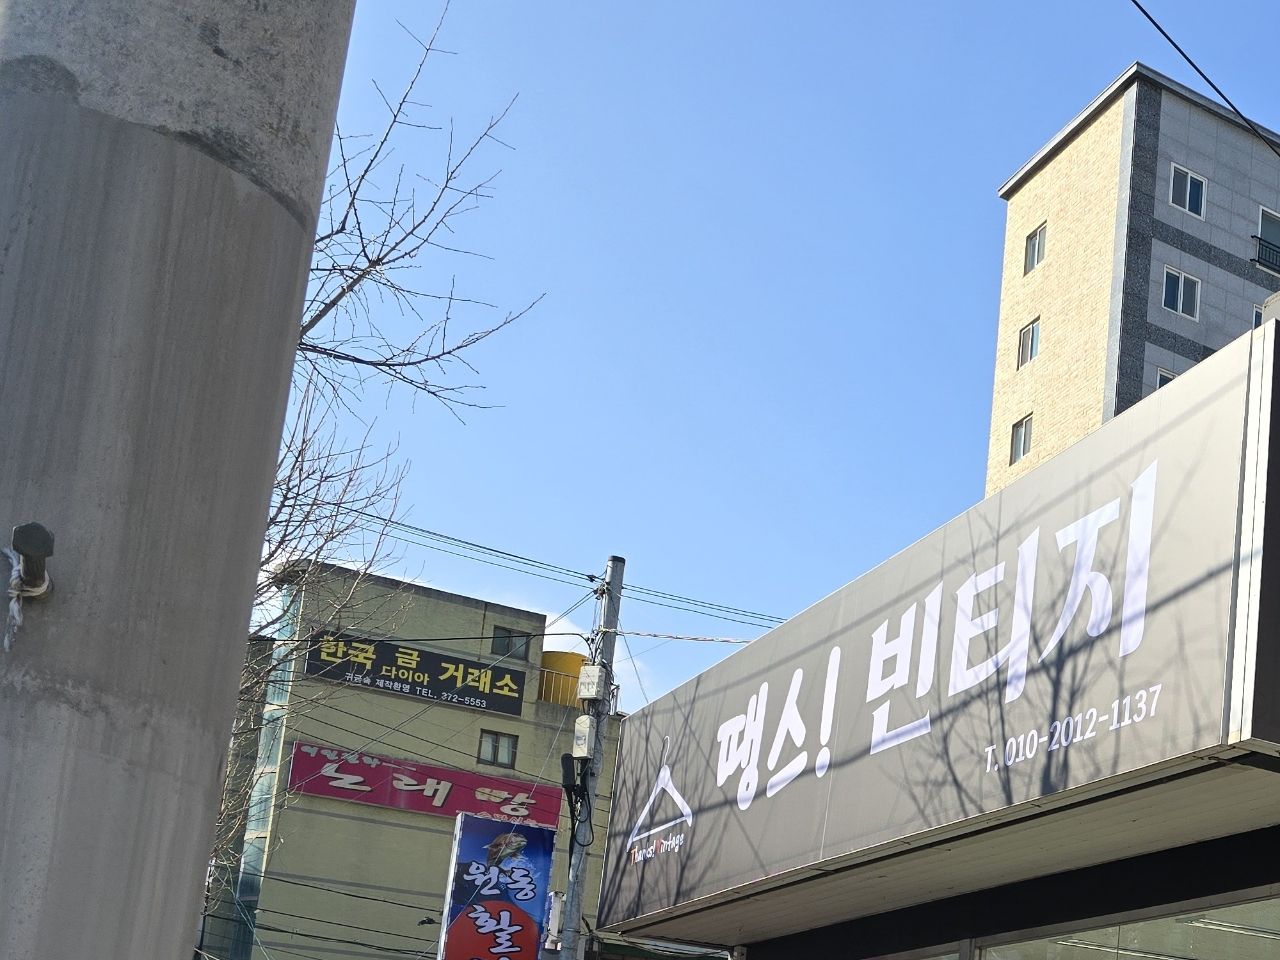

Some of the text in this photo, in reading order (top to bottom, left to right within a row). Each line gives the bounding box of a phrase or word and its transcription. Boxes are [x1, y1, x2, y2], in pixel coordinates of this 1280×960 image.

[717, 457, 1159, 811] 땡스! 빈티지
[319, 635, 520, 698] 한국 금 거래소
[380, 666, 430, 686] 다이아
[375, 678, 411, 693] 제작환영
[415, 686, 438, 699] TEL.
[441, 691, 487, 708] 372-5553
[984, 684, 1163, 773] T. 010-2012-1137
[463, 861, 537, 900] 원동
